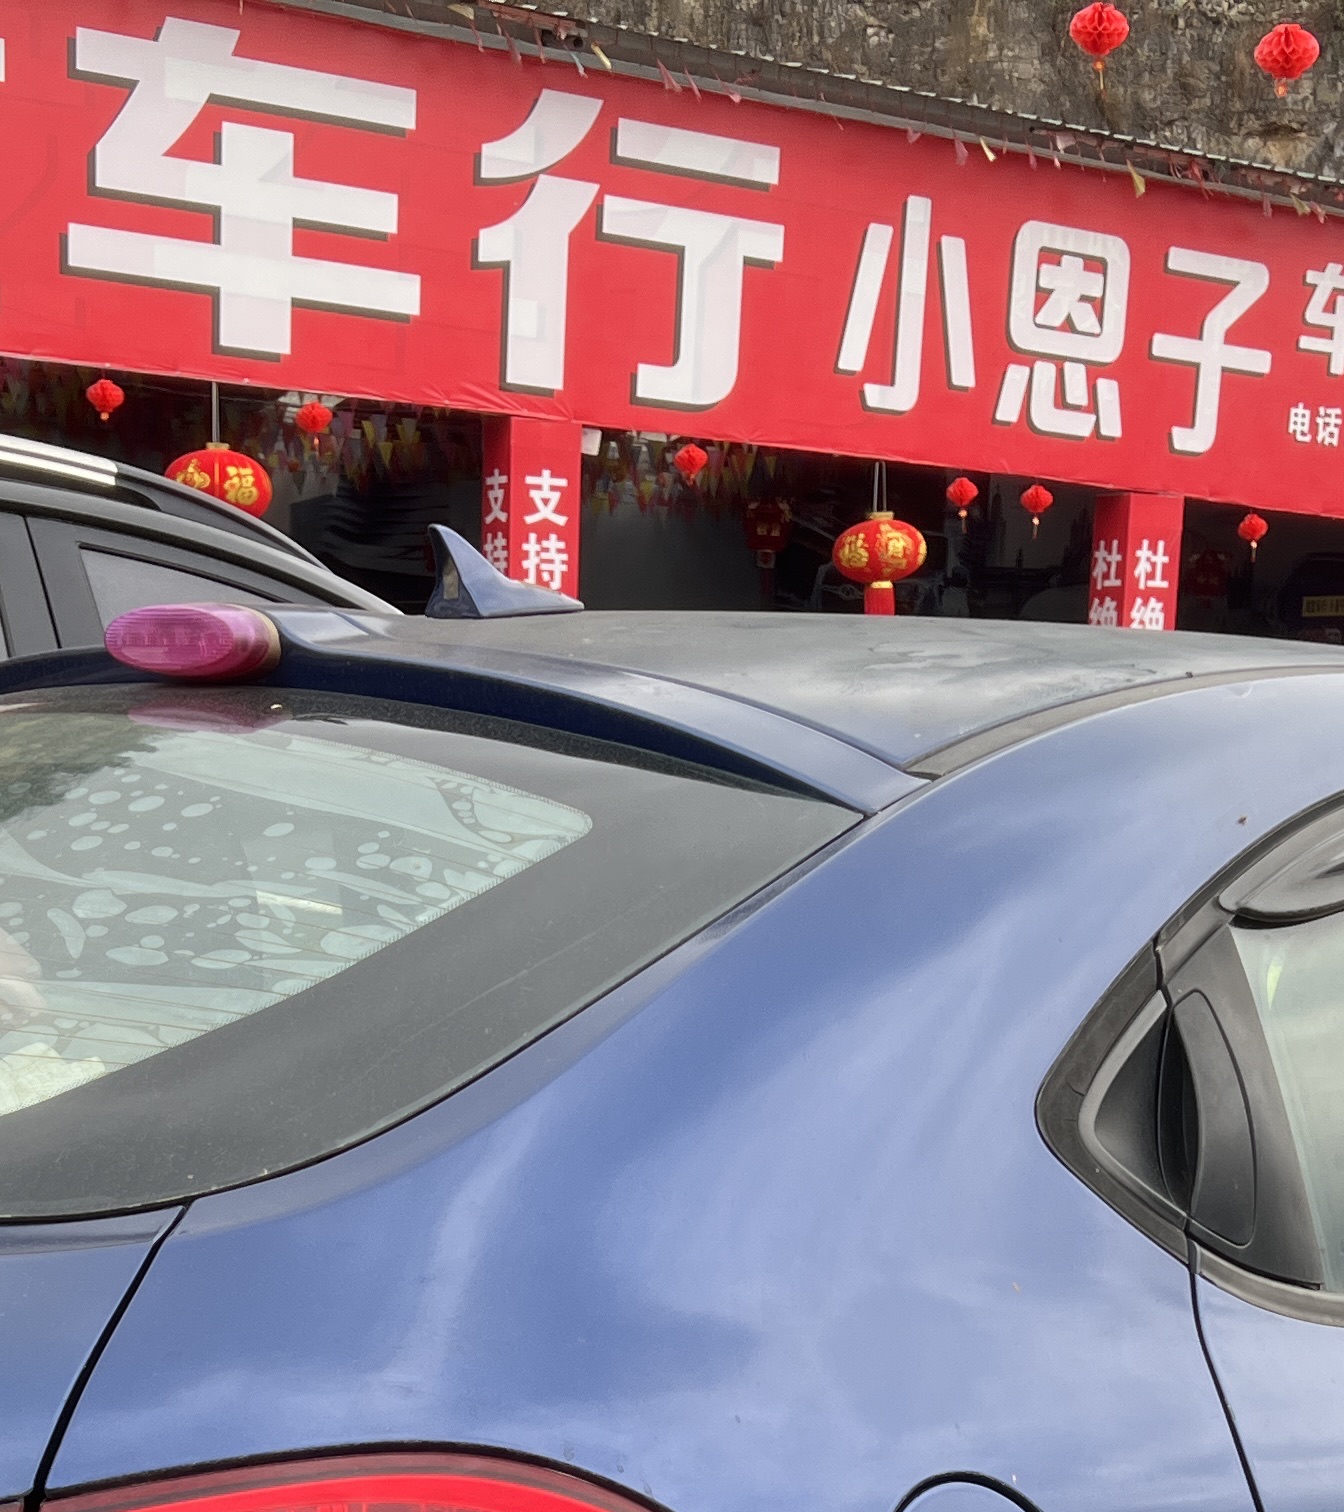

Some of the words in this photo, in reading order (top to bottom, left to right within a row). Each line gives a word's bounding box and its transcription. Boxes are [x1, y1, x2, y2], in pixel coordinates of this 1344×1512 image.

[835, 194, 1273, 455] 小恩子
[520, 468, 570, 591] 支持
